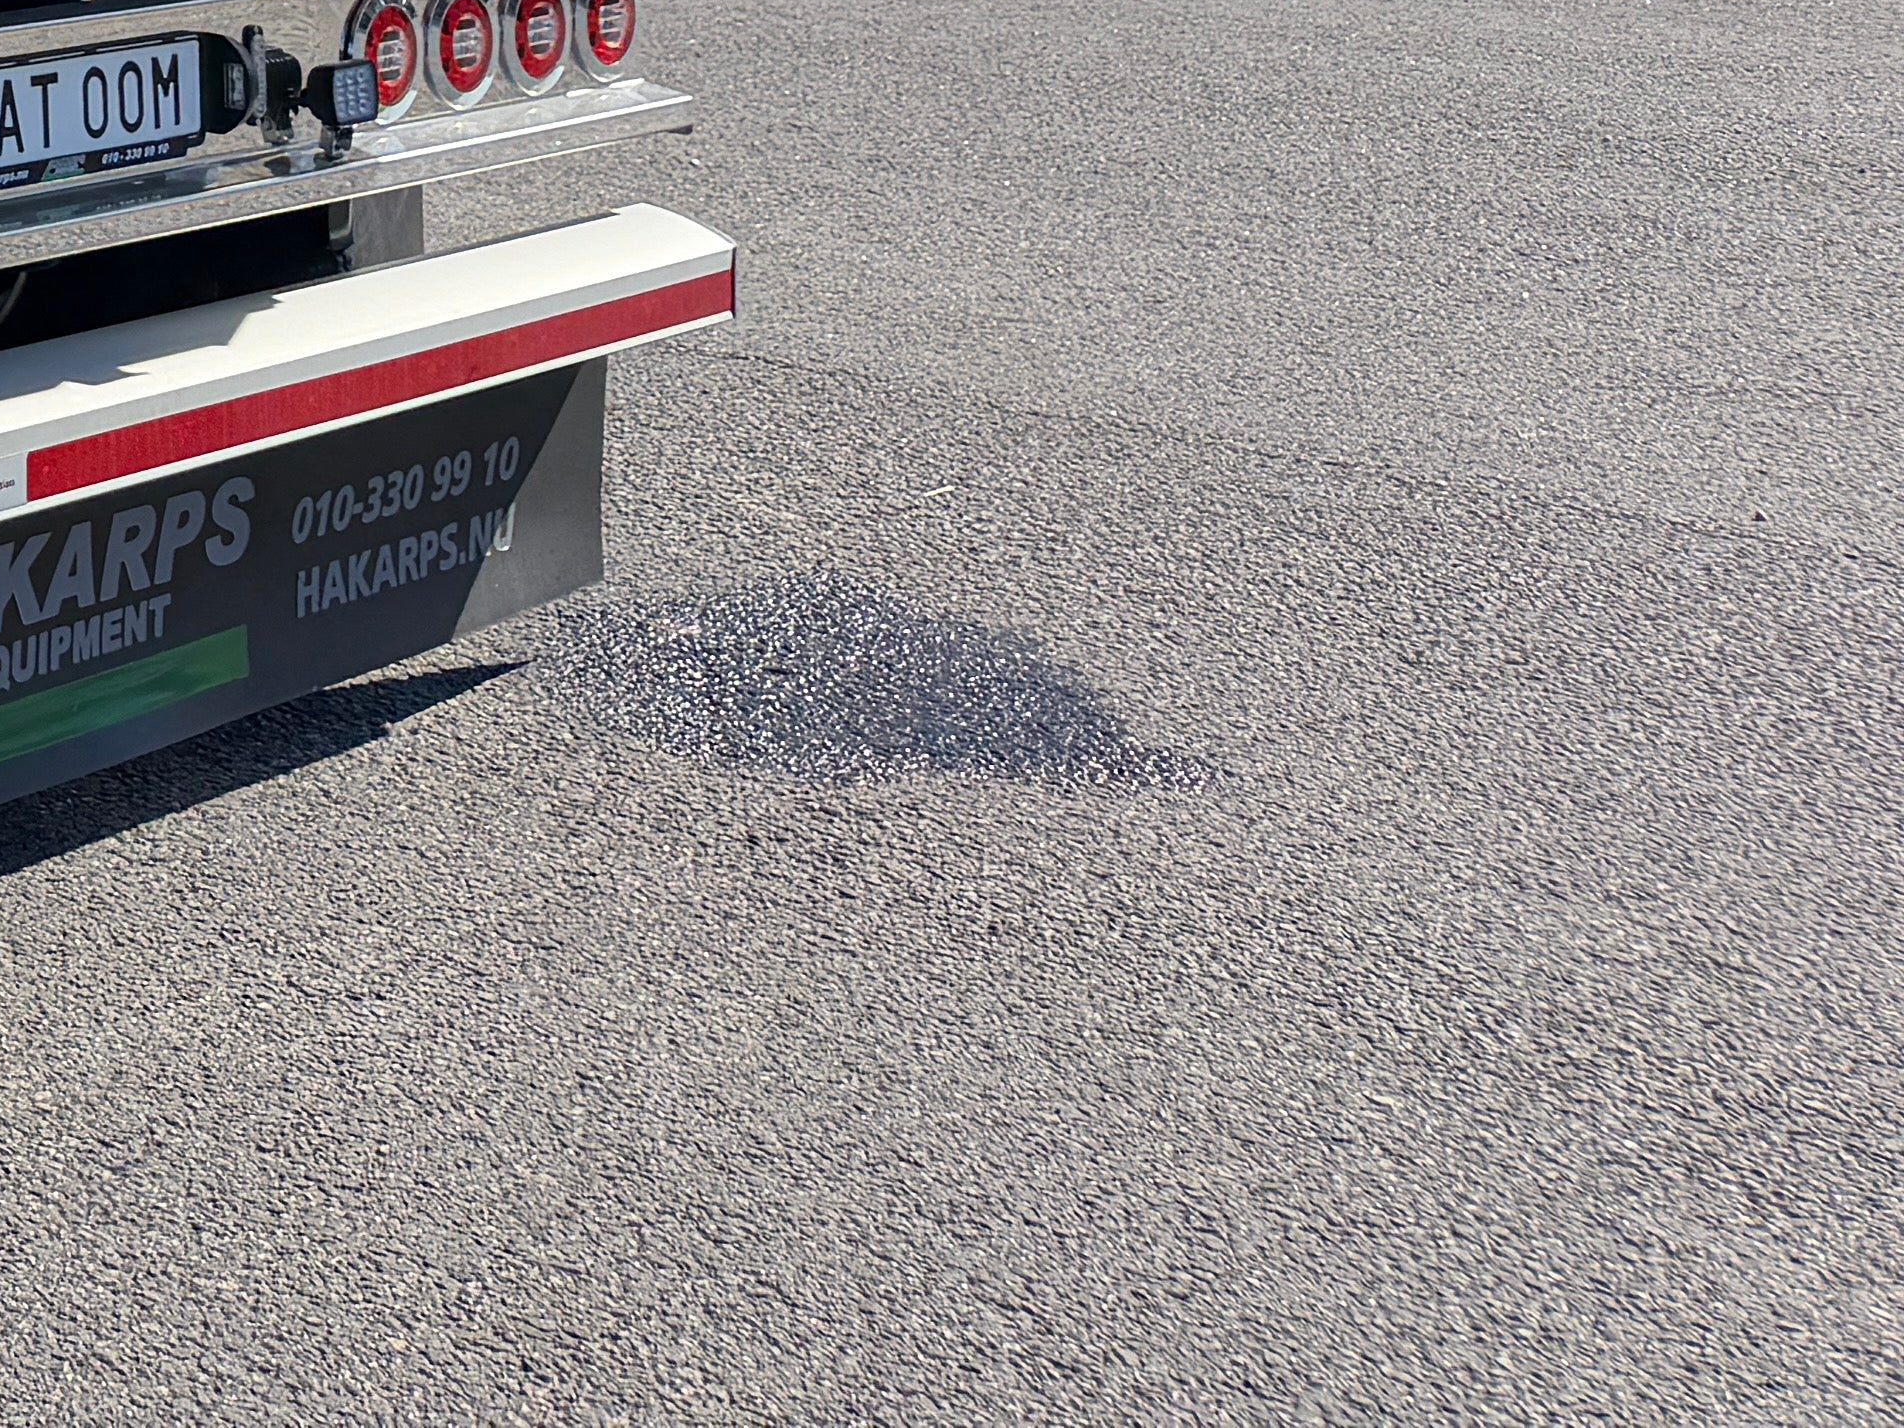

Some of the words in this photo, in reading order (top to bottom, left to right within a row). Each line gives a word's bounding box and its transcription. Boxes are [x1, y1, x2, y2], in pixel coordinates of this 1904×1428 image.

[291, 463, 425, 544] 010-330
[430, 450, 473, 502] 99
[483, 435, 520, 487] 10
[296, 501, 517, 619] HAKARPS.NU
